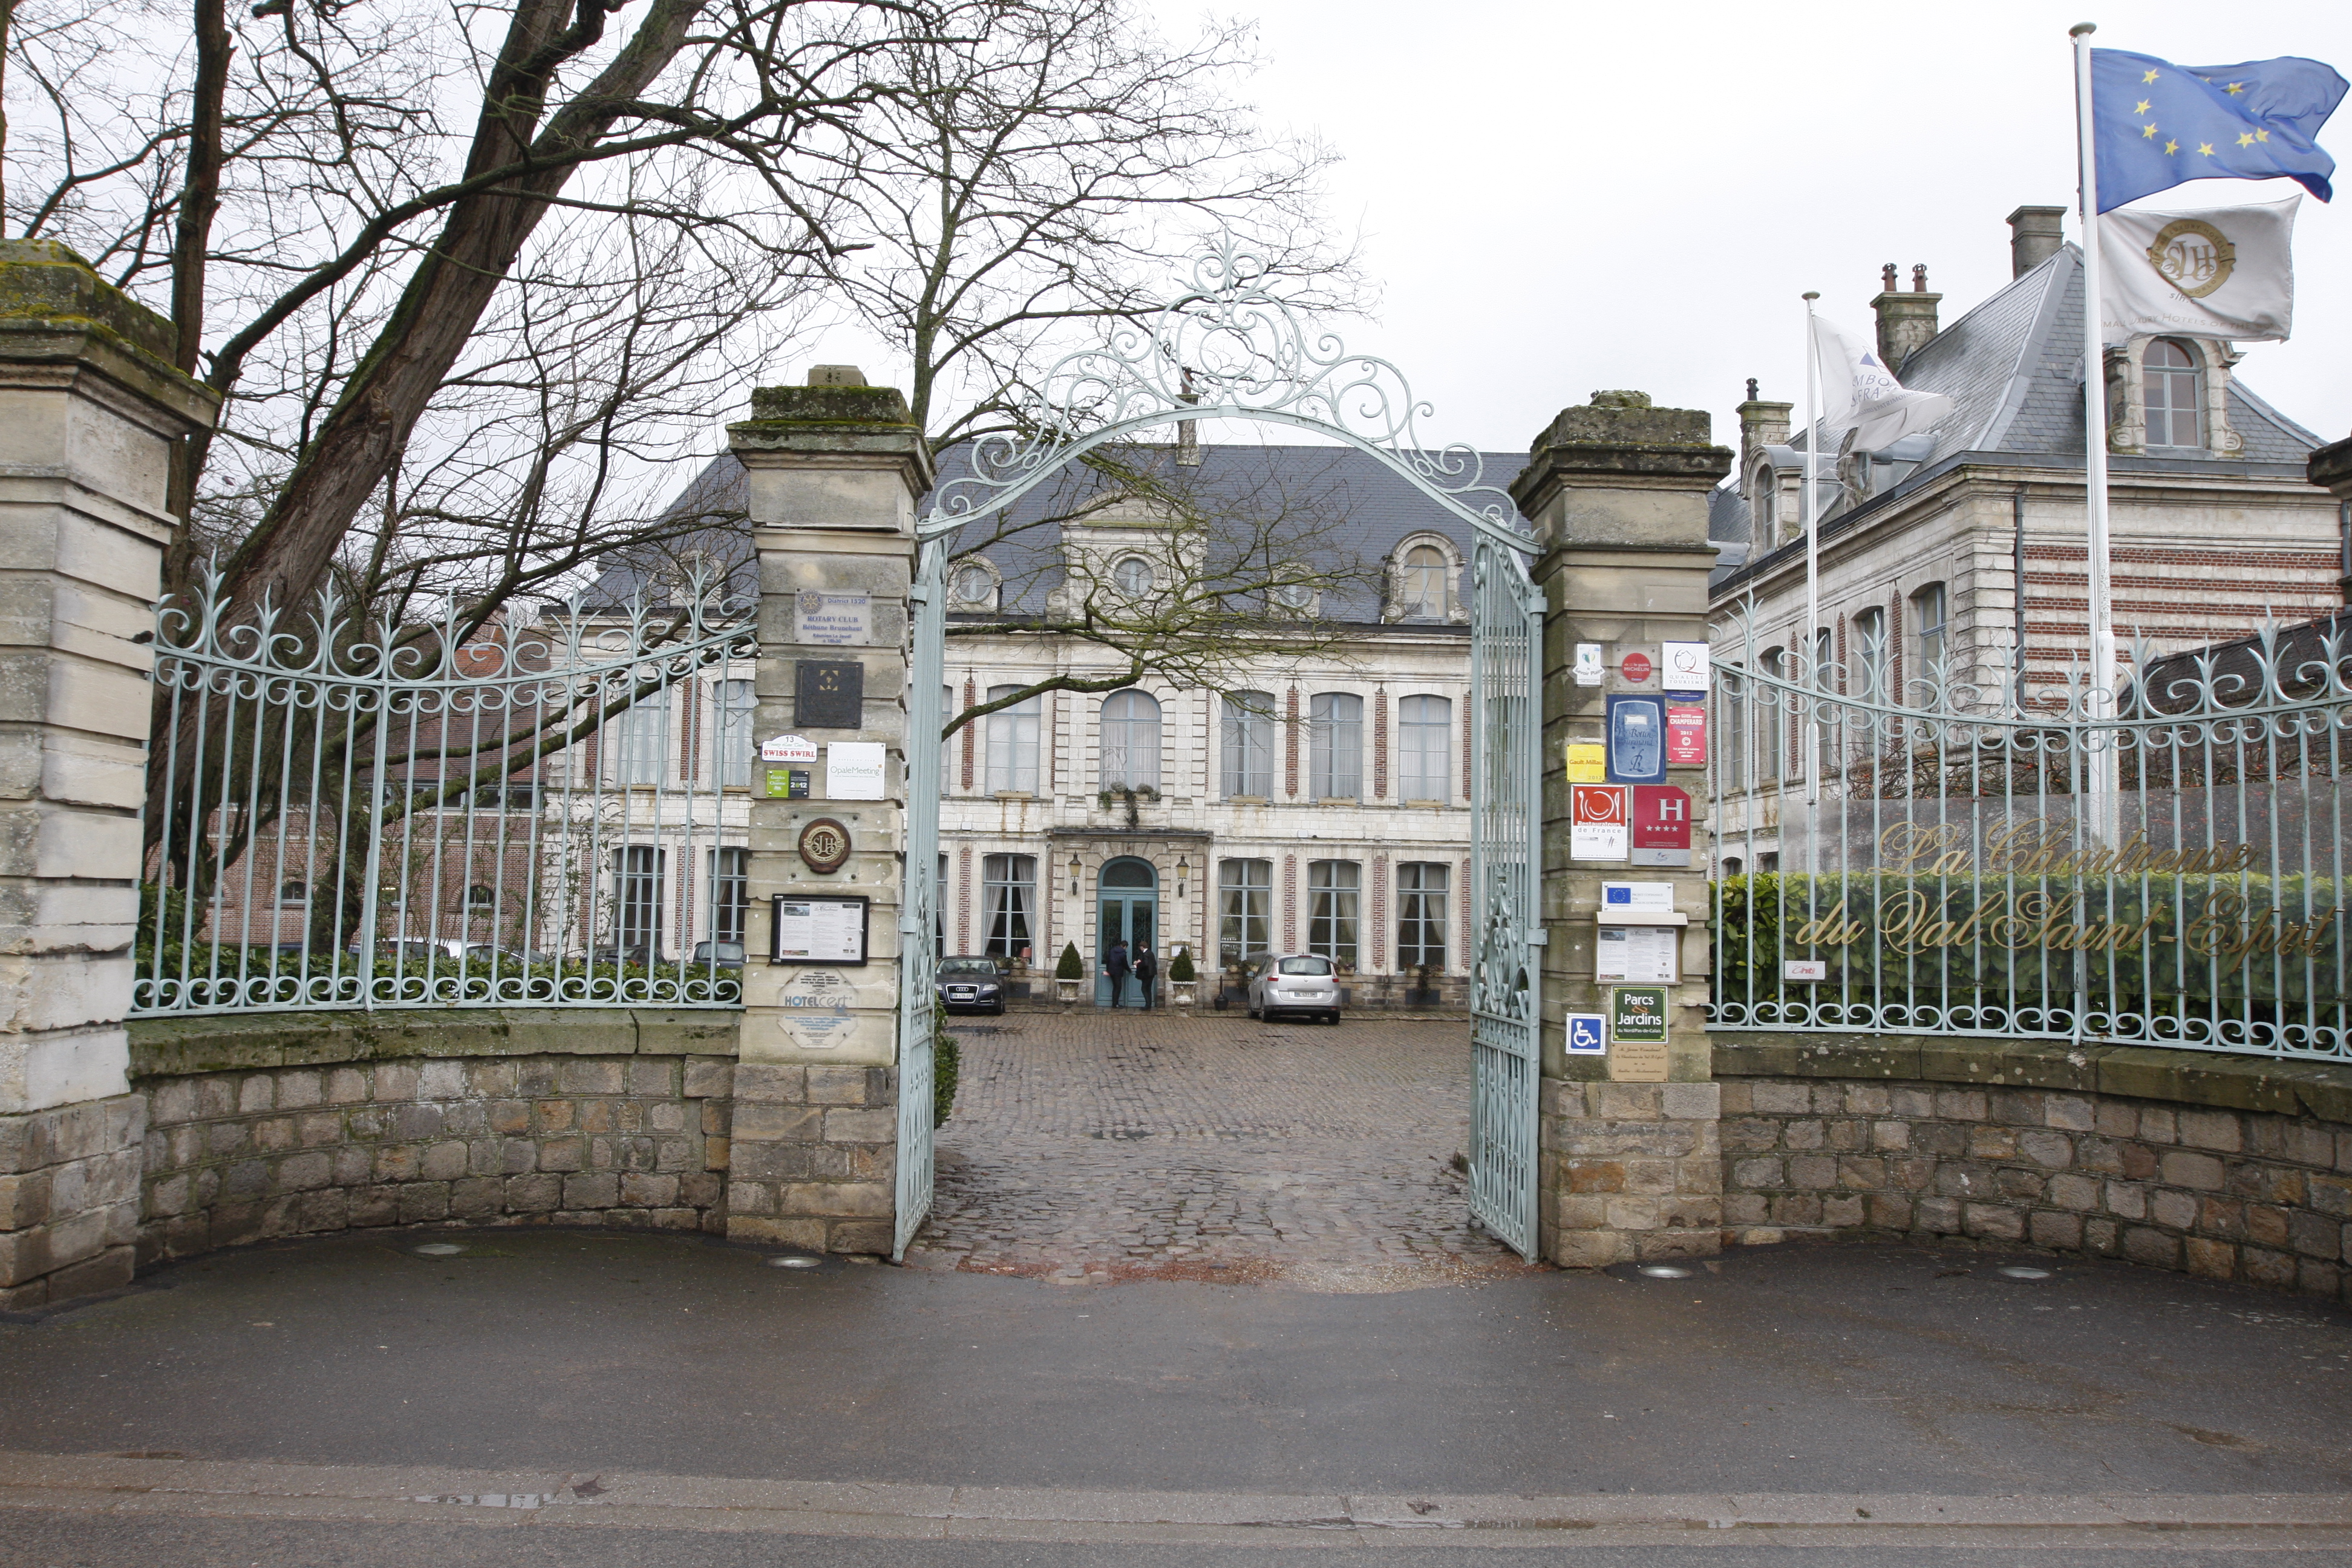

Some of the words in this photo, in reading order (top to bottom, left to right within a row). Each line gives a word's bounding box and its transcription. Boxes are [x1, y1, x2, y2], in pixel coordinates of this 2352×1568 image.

[830, 765, 880, 776] OpaleMeeting
[1658, 799, 1685, 821] H
[1867, 821, 1974, 878] La
[1985, 817, 2259, 877] Chartreuse
[1795, 900, 1866, 945] du
[1875, 889, 2007, 955] Val
[1624, 993, 1655, 1005] Parcs
[1631, 1004, 1650, 1013] &
[1617, 1012, 1662, 1025] Jardins
